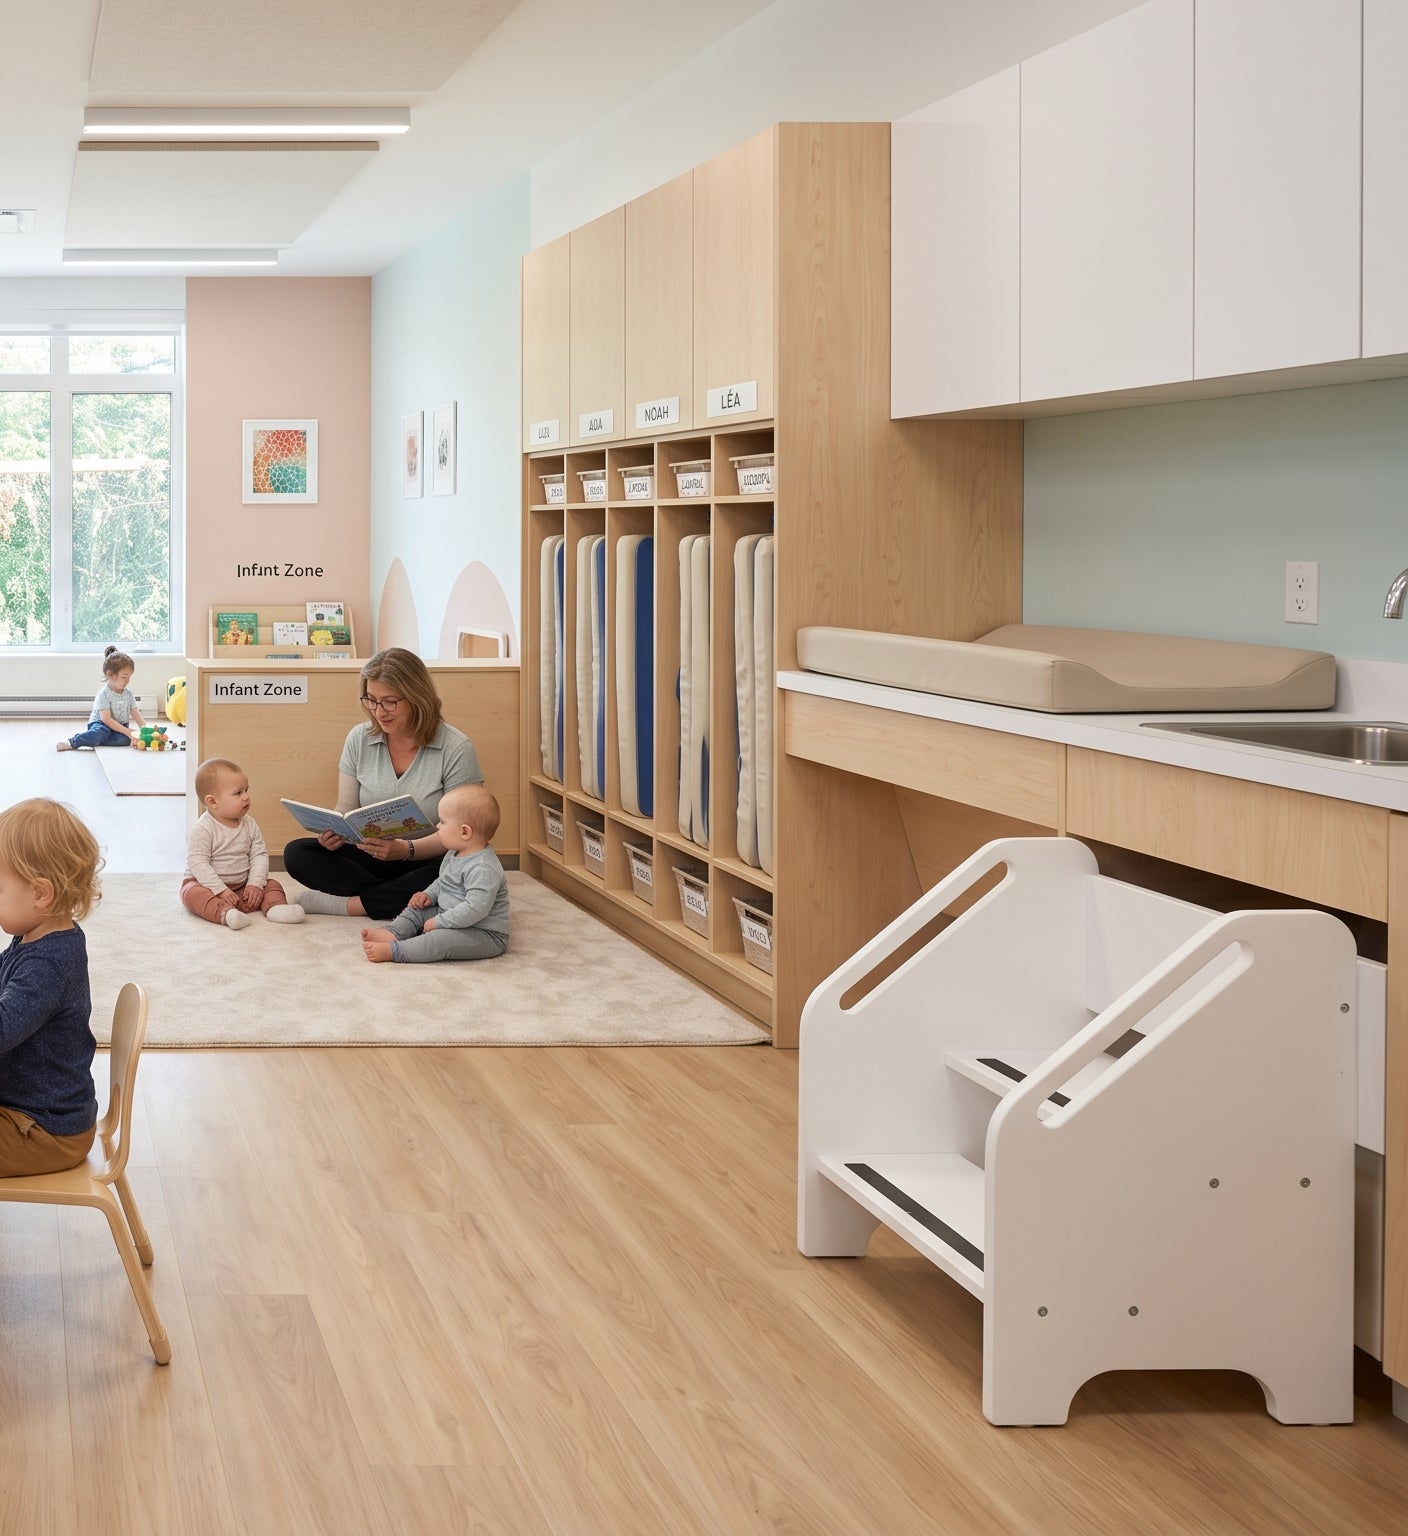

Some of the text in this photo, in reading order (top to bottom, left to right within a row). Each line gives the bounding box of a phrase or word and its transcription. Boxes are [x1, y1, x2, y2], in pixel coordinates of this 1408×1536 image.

[721, 389, 741, 410] LÉA
[645, 405, 669, 422] NOAH
[284, 563, 324, 578] Zone
[215, 682, 302, 696] Infant Zone
